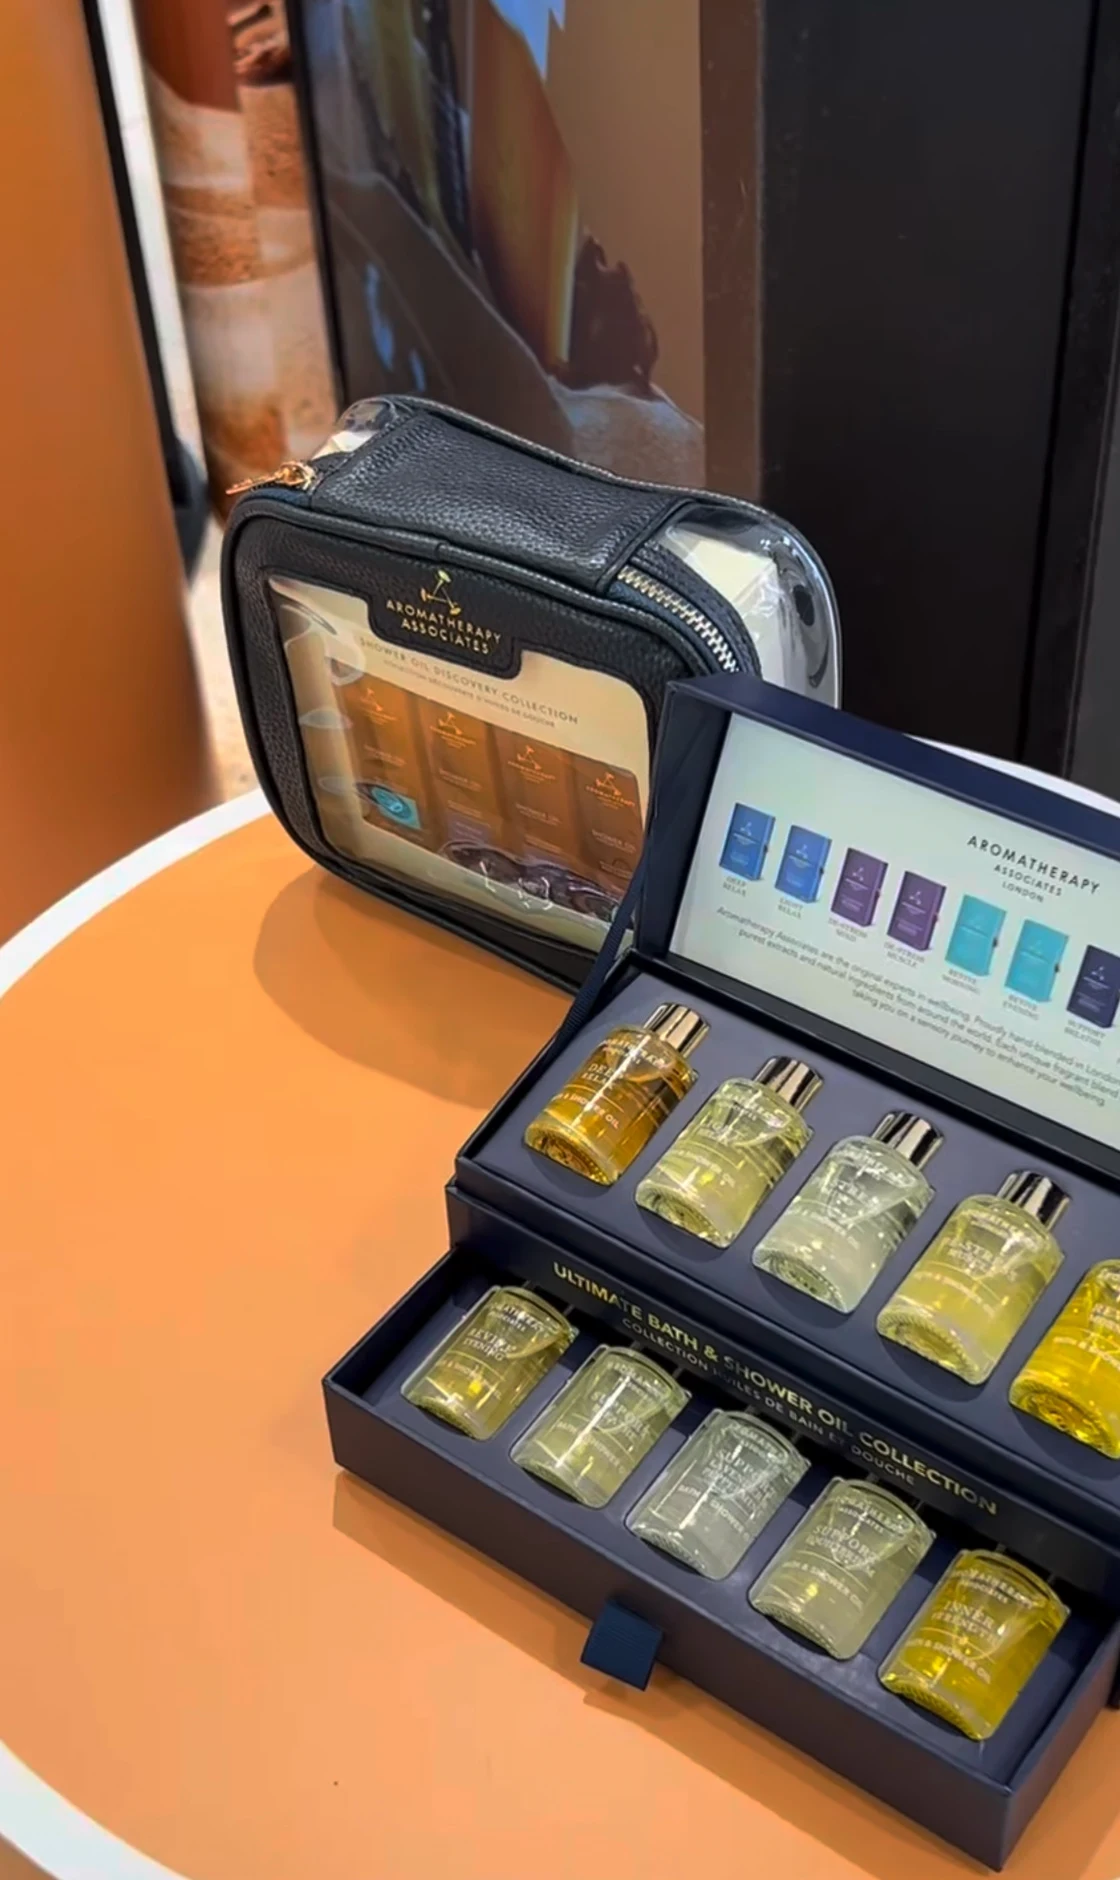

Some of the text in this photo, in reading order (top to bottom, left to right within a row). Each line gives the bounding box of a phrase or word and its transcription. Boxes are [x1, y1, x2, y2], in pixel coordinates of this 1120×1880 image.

[386, 599, 501, 644] AROMATHERAPY
[401, 618, 489, 655] ASSOCIATES
[360, 637, 578, 725] SHOWER OIL DISCOVERY COLLECTION
[967, 835, 1100, 895] AROMATHERAPY
[993, 864, 1062, 897] ASSOCIATES
[1001, 881, 1044, 903] LONDON
[717, 906, 775, 938] Aromatherapy
[776, 930, 819, 956] Associates
[821, 949, 835, 962] are
[835, 954, 850, 968] the
[851, 961, 883, 984] original
[883, 976, 917, 999] experts
[973, 1015, 1007, 1038] Proudly
[738, 928, 766, 947] purest
[766, 940, 799, 960] extracts
[799, 953, 816, 967] and
[816, 960, 847, 980] natural
[848, 971, 895, 1002] ingredients
[896, 991, 917, 1011] from
[917, 1005, 949, 1025] around
[950, 1018, 965, 1031] the
[995, 1036, 1018, 1055] Each
[1019, 1048, 1052, 1071] unique
[878, 1001, 895, 1015] you
[897, 1008, 909, 1019] on
[917, 1016, 950, 1039] sensory
[950, 1032, 985, 1055] journey
[985, 1046, 996, 1058] to
[997, 1052, 1036, 1076] enhance
[1036, 1070, 1057, 1086] your
[570, 1095, 606, 1117] SHOER
[605, 1113, 620, 1129] OIL
[554, 1261, 643, 1321] ULTIMATE
[648, 1313, 698, 1351] BATH
[703, 1344, 719, 1363] &
[723, 1354, 813, 1415] SHOWER
[818, 1408, 854, 1437] OIL
[859, 1431, 998, 1516] COLLECTION
[622, 1317, 708, 1372] COLLECTION
[765, 1396, 784, 1413] DE
[789, 1406, 824, 1436] BAIN
[851, 1445, 916, 1486] DOUCHE
[944, 1600, 995, 1629] INNER
[976, 1666, 991, 1685] OIL
